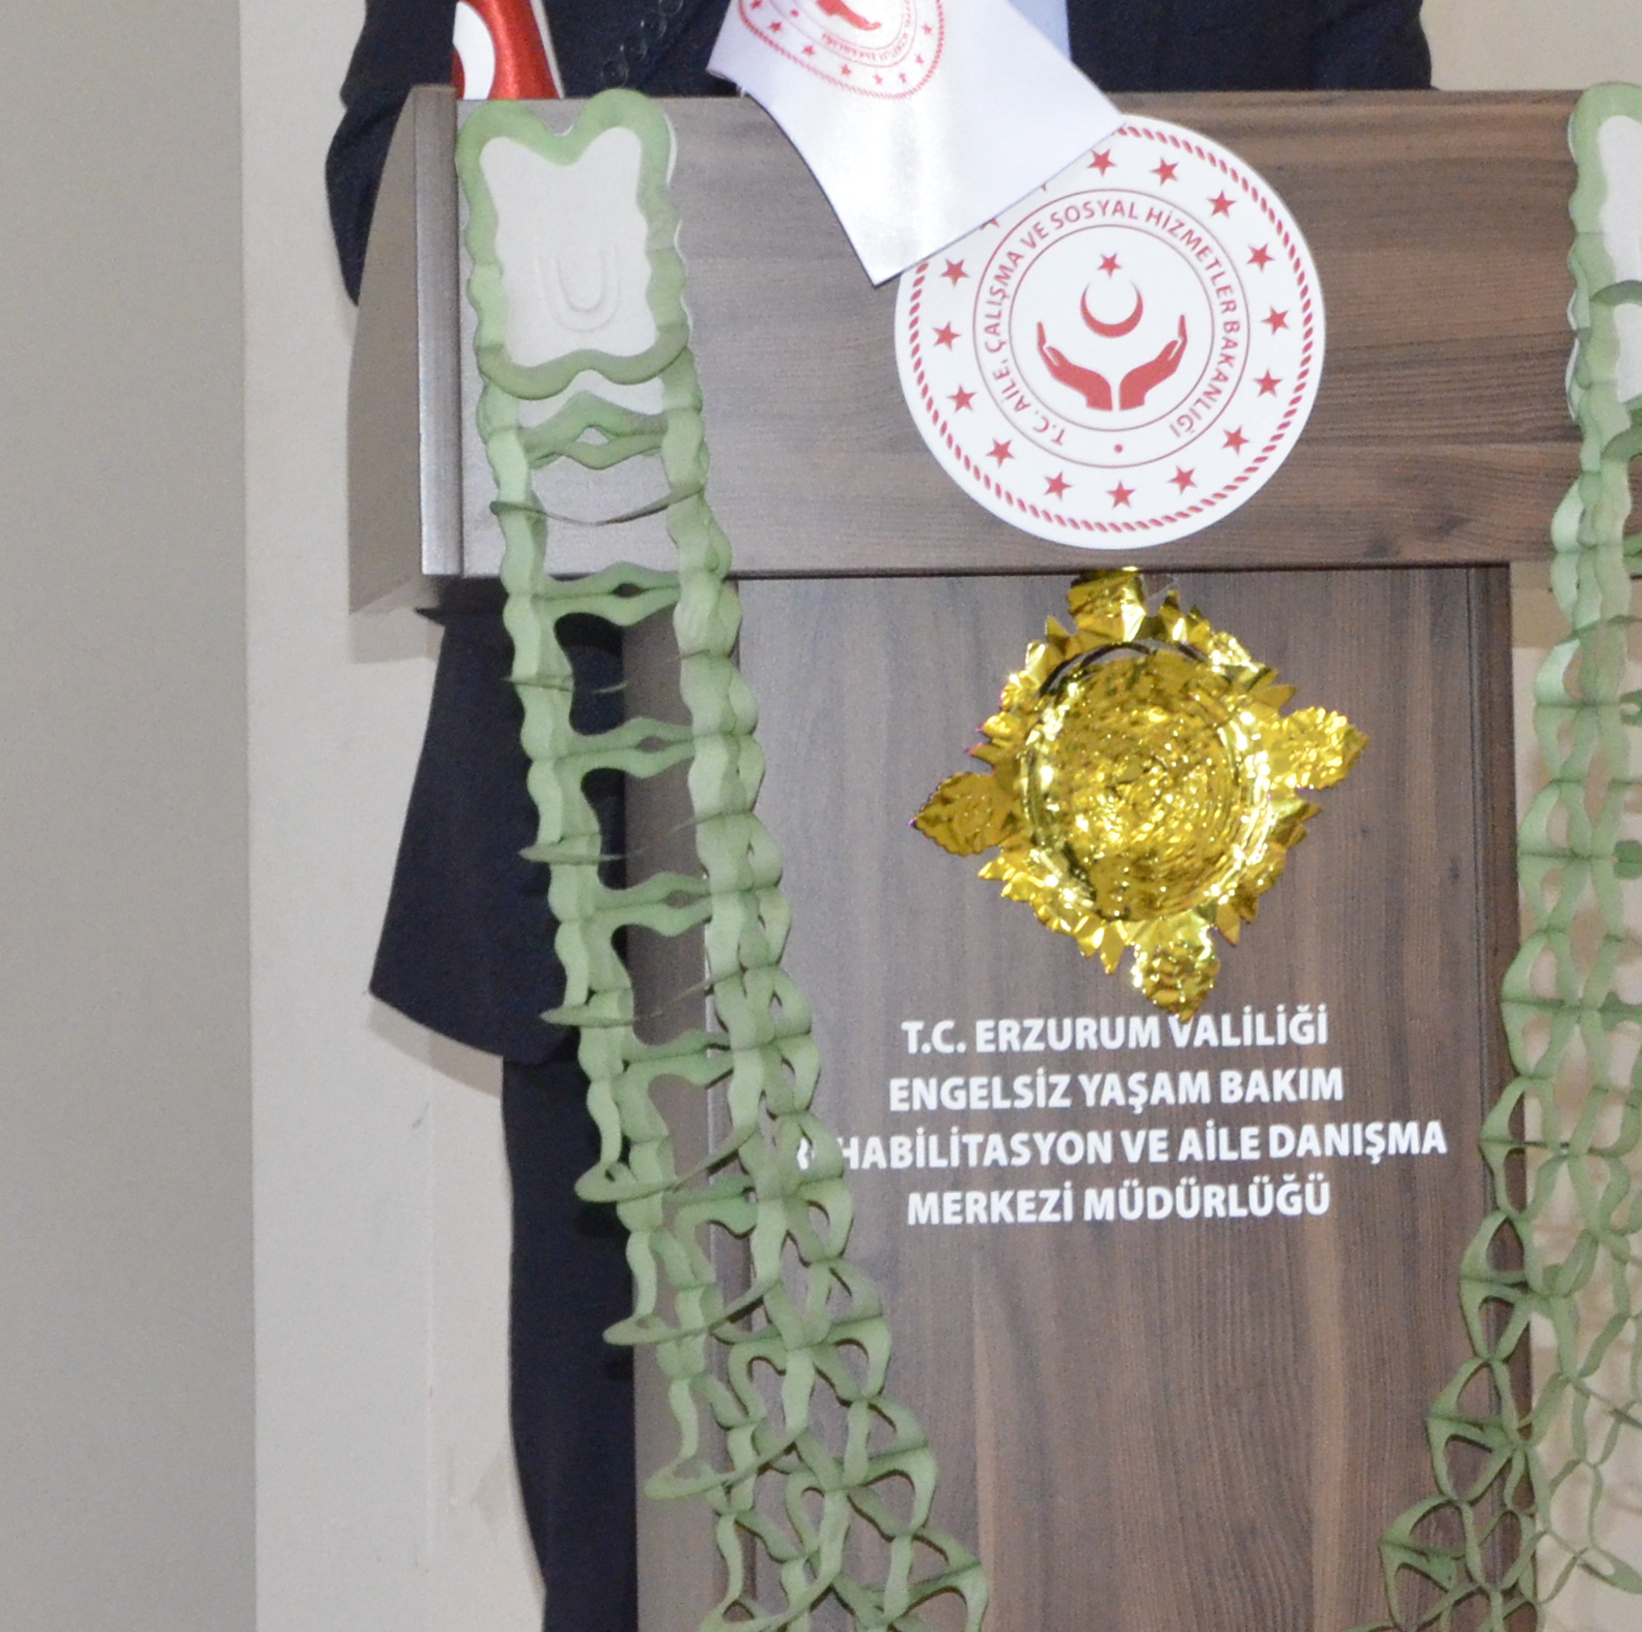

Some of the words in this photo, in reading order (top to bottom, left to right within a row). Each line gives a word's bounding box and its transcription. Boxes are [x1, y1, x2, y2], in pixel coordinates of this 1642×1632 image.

[1019, 220, 1049, 249] VE
[1050, 199, 1139, 230] SOSYAL
[1145, 206, 1238, 314] HİZMETLER
[984, 251, 1024, 354] ÇALIŞMA
[1168, 320, 1241, 438] BAKANLIĞI
[1032, 411, 1066, 446] T.C.
[900, 1019, 967, 1055] T.C.
[974, 1015, 1160, 1053] ERZURUM
[1167, 1002, 1328, 1049] VALİLİĞİ
[889, 1066, 1072, 1112] ENGELSİZ
[1077, 1070, 1211, 1115] YAŞAM
[1219, 1067, 1344, 1104] BAKIM
[796, 1125, 1112, 1171] HABİLİTASYON
[1119, 1128, 1169, 1164] VE
[1177, 1119, 1261, 1162] AİLE
[1268, 1120, 1448, 1165] DANIŞMA
[907, 1180, 1074, 1226] MERKEZİ
[1083, 1172, 1331, 1222] MÜDÜRLÜĞÜ
